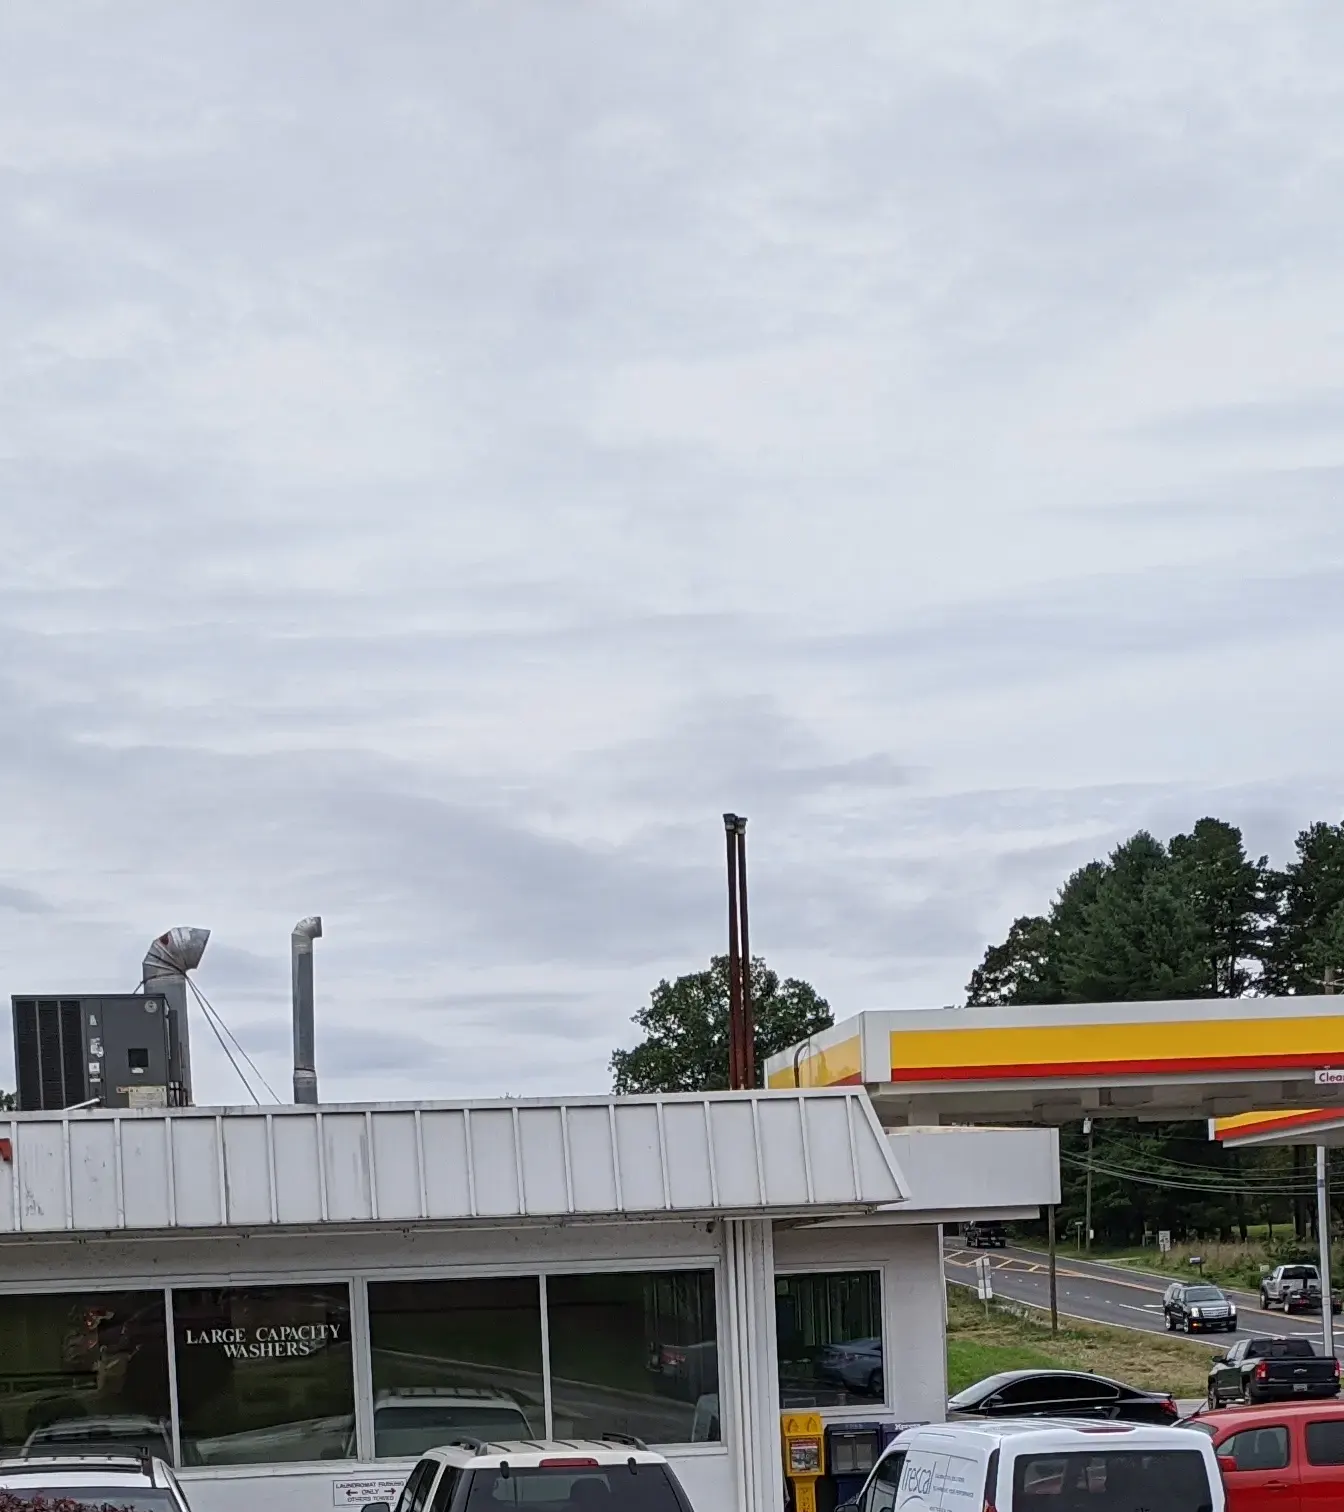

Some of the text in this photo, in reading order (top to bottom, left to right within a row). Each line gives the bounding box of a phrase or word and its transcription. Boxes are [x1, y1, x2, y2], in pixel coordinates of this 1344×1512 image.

[186, 1323, 341, 1345] LARGE CAPACITY
[223, 1341, 310, 1358] WASHERS
